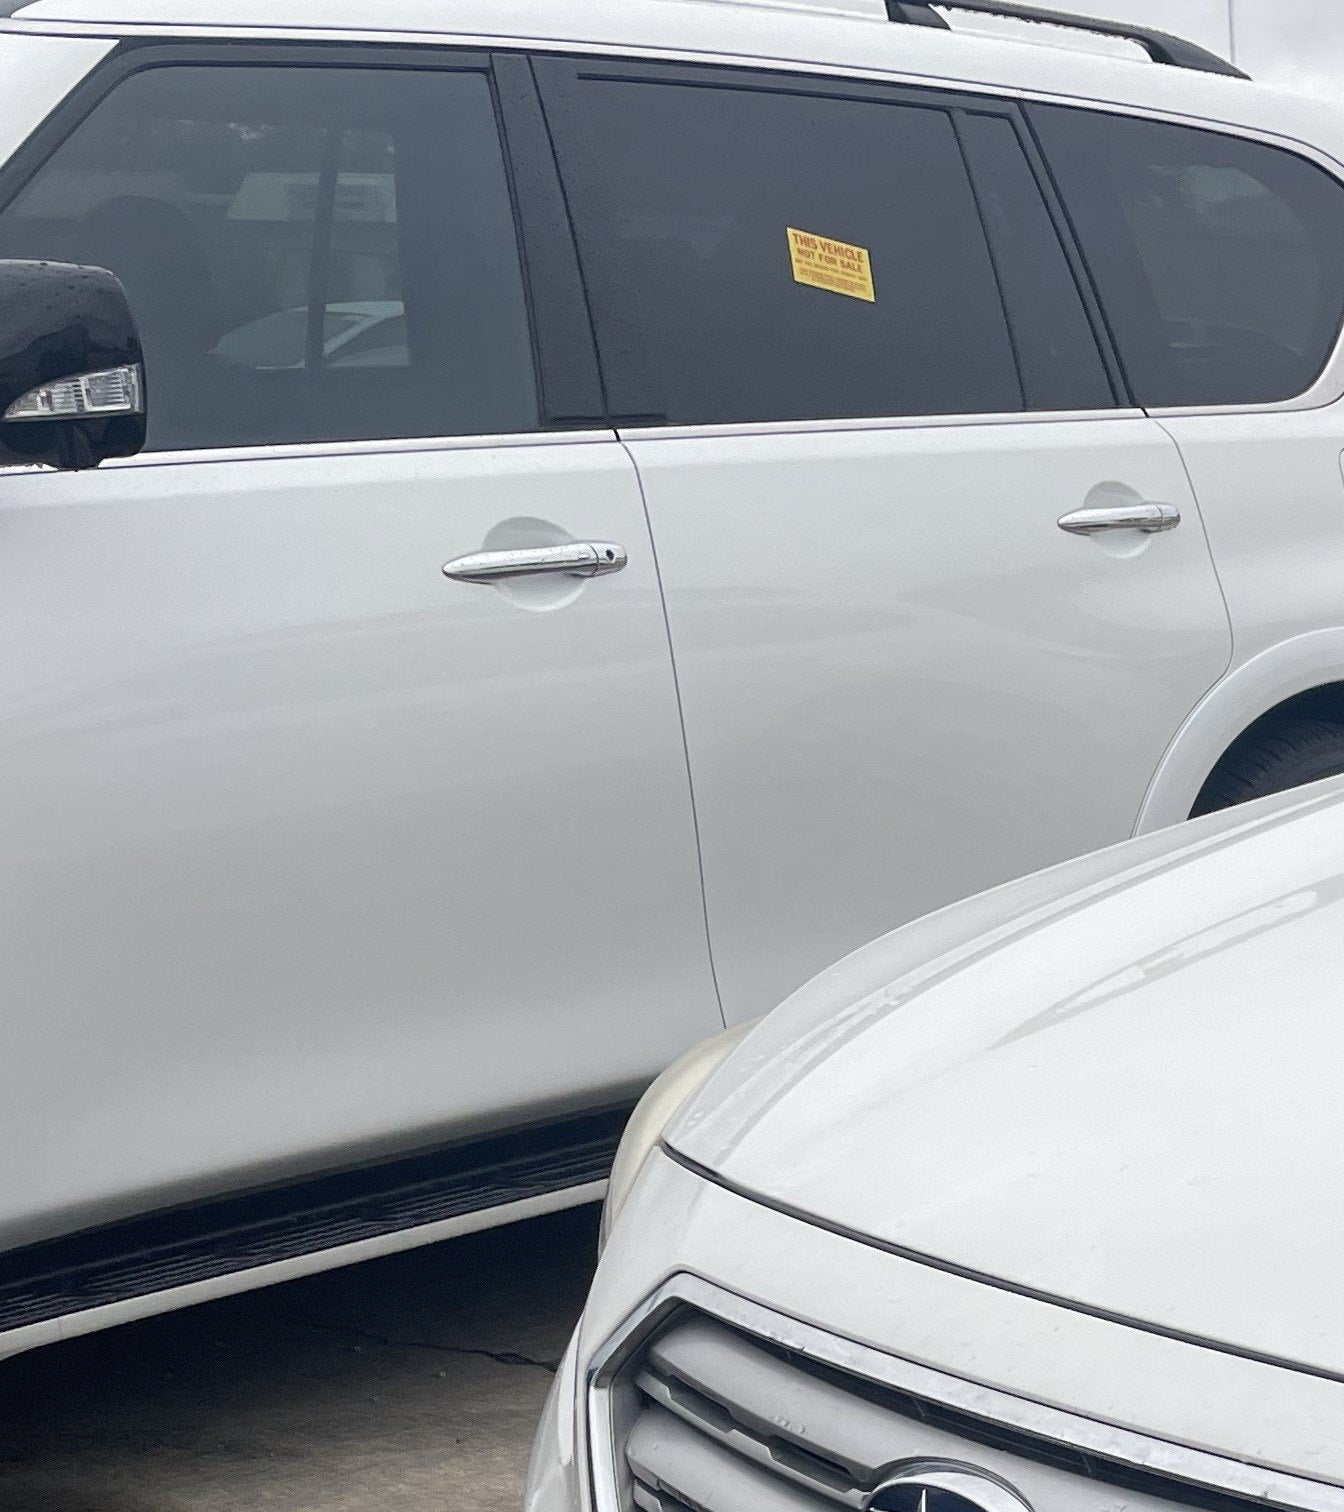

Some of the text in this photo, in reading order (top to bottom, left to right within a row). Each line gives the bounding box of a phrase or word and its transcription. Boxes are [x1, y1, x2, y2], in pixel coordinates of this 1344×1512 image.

[793, 233, 864, 263] THIS VEHICLE
[797, 248, 815, 260] NOT
[819, 254, 837, 266] FOR
[840, 260, 863, 274] SALE
